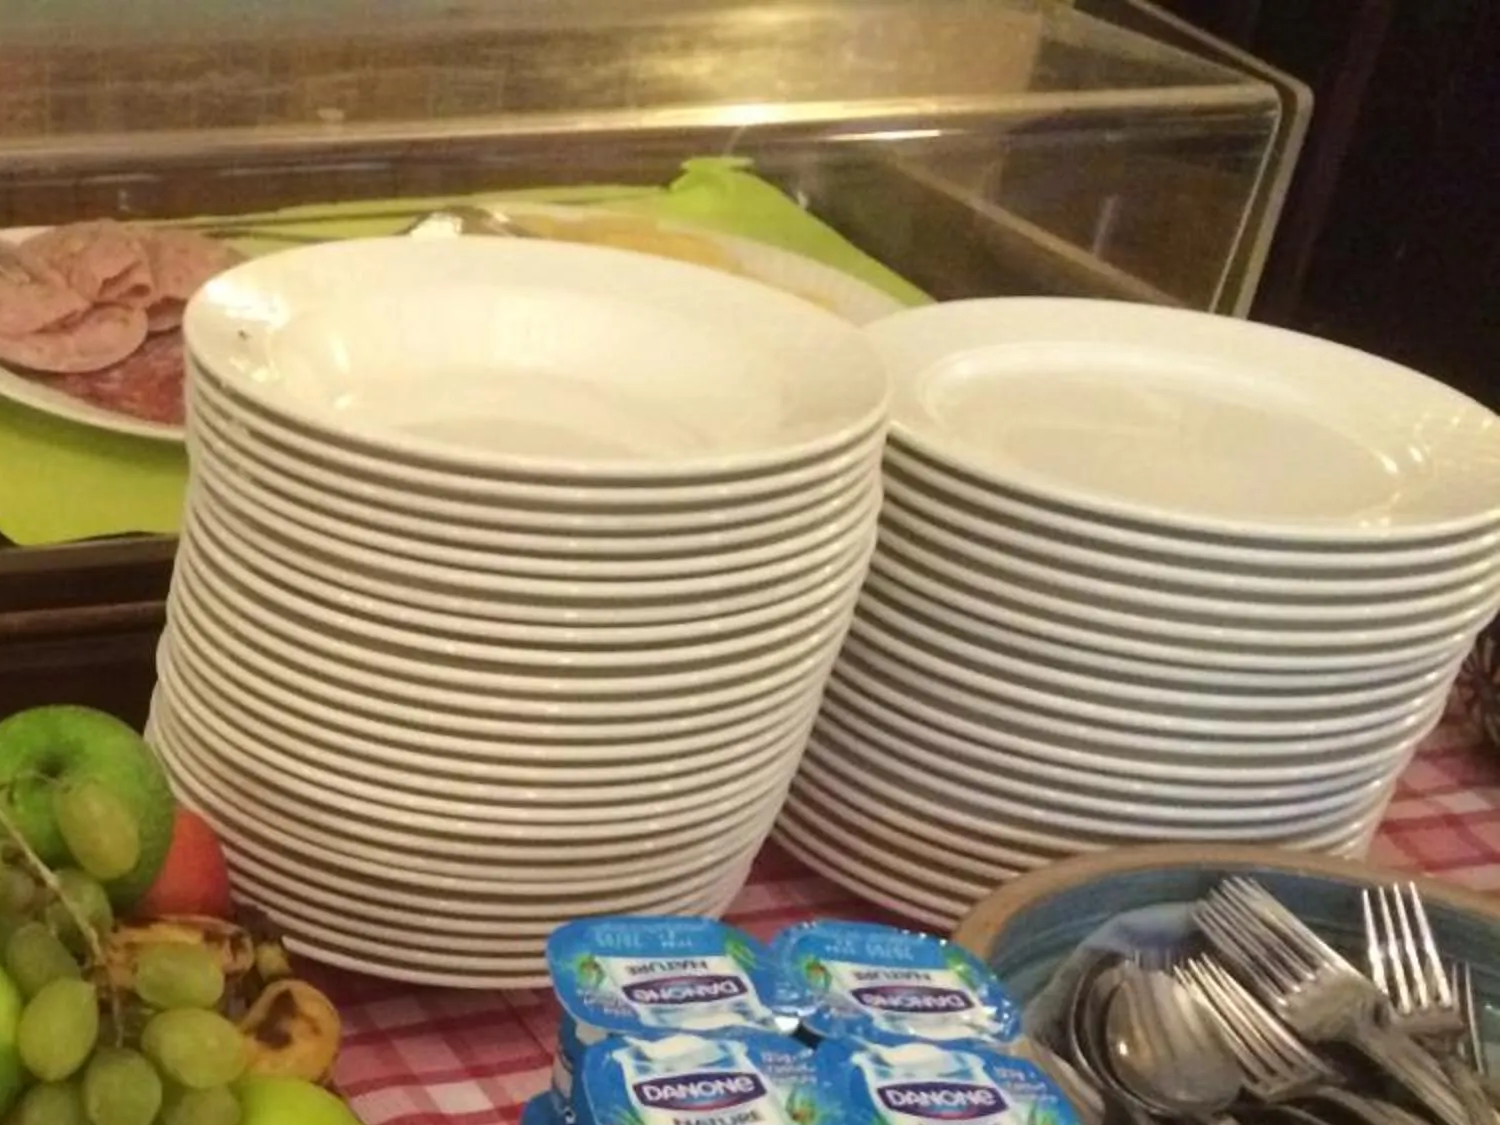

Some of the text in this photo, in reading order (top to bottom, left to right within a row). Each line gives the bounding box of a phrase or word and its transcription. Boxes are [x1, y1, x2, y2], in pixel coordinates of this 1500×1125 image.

[632, 980, 739, 1002] DANONE
[641, 1075, 755, 1102] DANONE
[886, 1089, 995, 1107] DANONE
